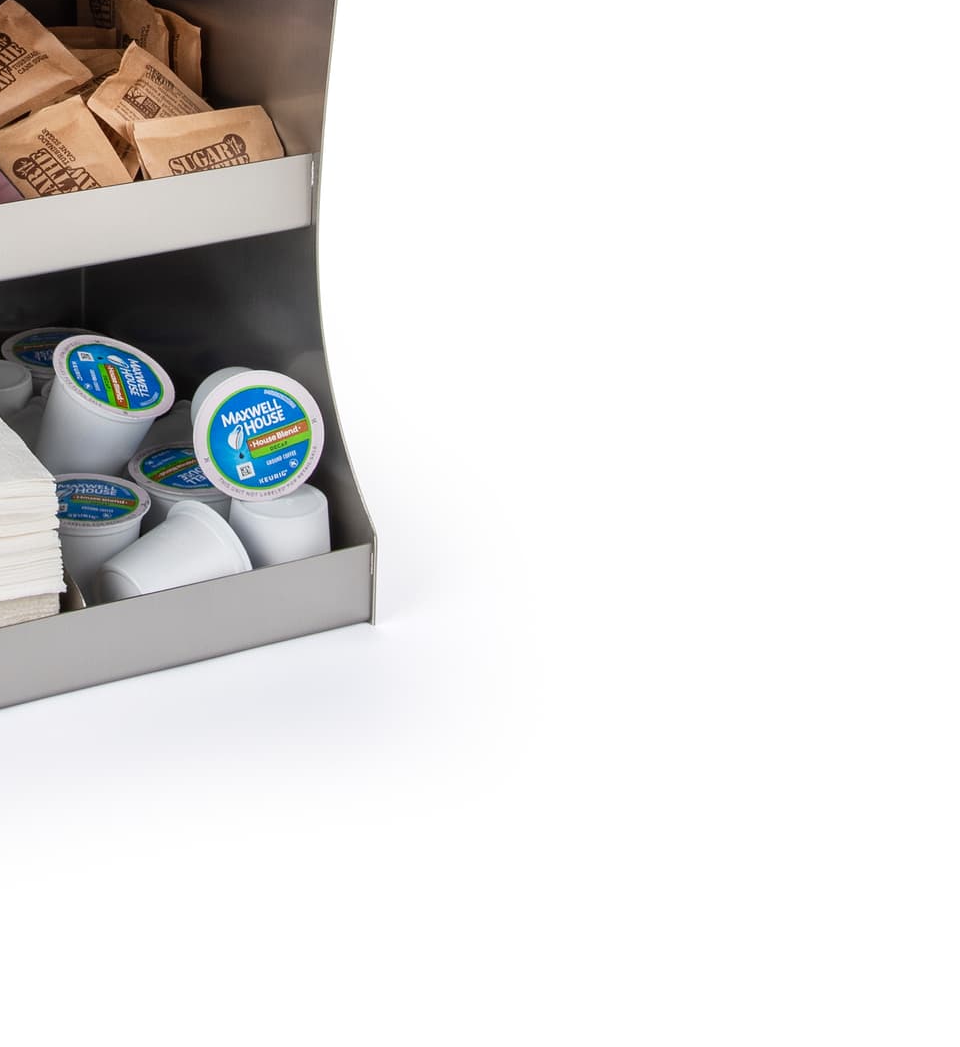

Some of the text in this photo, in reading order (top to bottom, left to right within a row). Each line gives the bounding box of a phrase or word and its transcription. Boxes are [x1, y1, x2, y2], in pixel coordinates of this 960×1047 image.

[168, 140, 236, 176] SUGAR
[120, 365, 140, 397] HOUSE
[128, 358, 150, 398] MAXWELL
[221, 398, 282, 428] MAXWELL
[243, 409, 286, 436] HOUSE
[251, 425, 299, 448] House Blend
[258, 470, 287, 485] KEURIG
[74, 488, 117, 496] HOUSE
